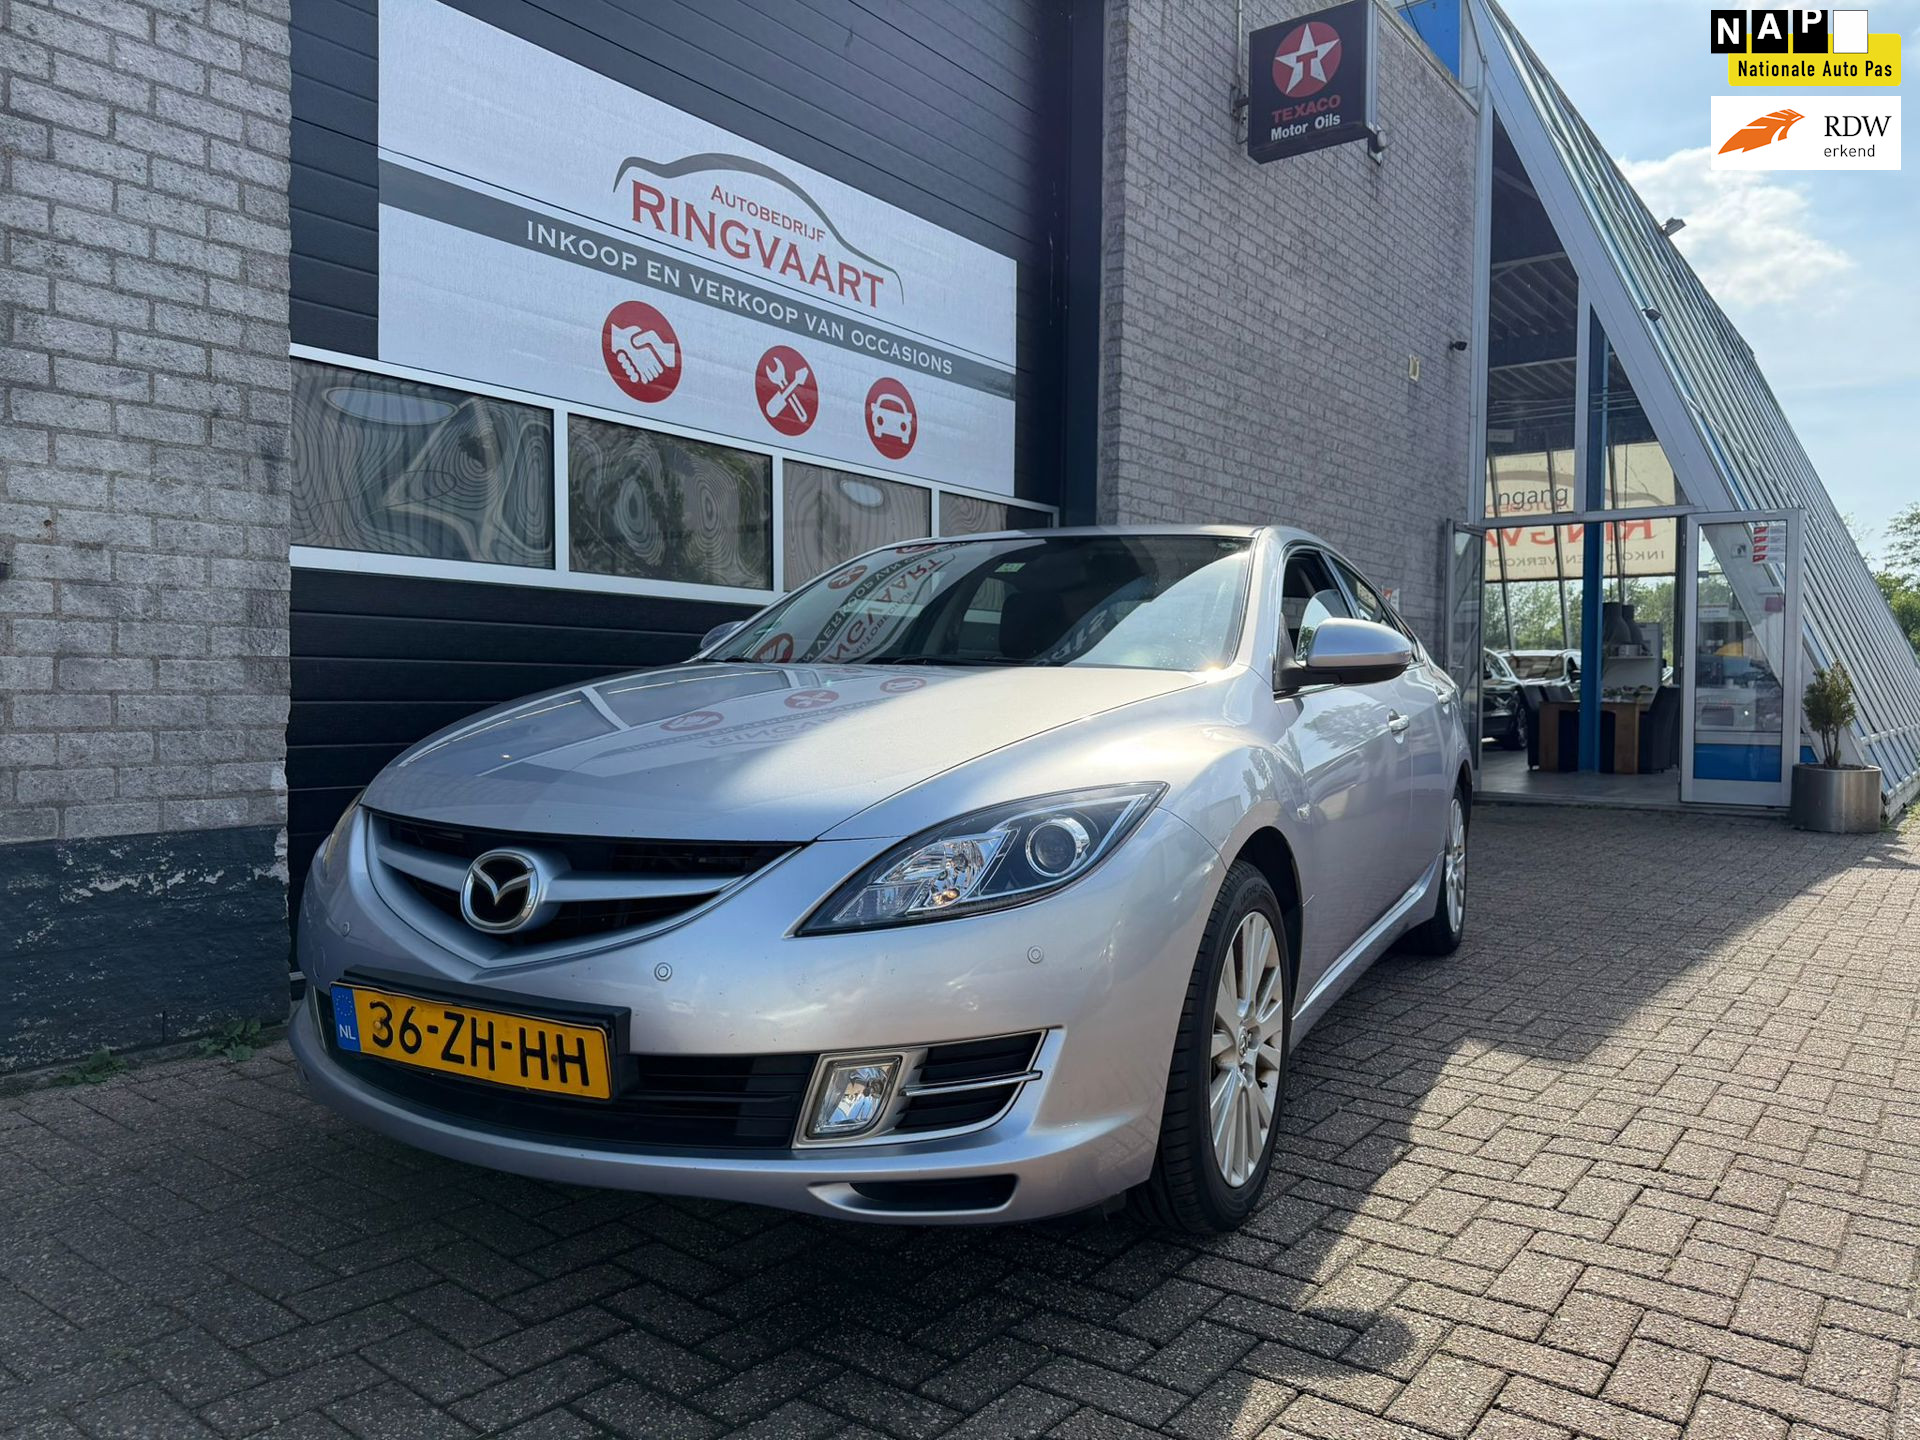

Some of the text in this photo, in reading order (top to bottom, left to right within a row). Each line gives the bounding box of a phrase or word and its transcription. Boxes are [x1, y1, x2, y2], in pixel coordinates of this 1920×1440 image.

[1271, 113, 1341, 141] Motor Oils
[1272, 94, 1341, 123] TEXACO
[711, 184, 826, 243] AUTOBEDRIJF
[631, 179, 884, 308] RINGVAART
[527, 219, 953, 376] INKOOP EN VERKOOP VAN OCCASIONS
[1497, 487, 1568, 510] ngang
[338, 1023, 357, 1042] NL
[369, 999, 591, 1087] 36-ZH-HH
